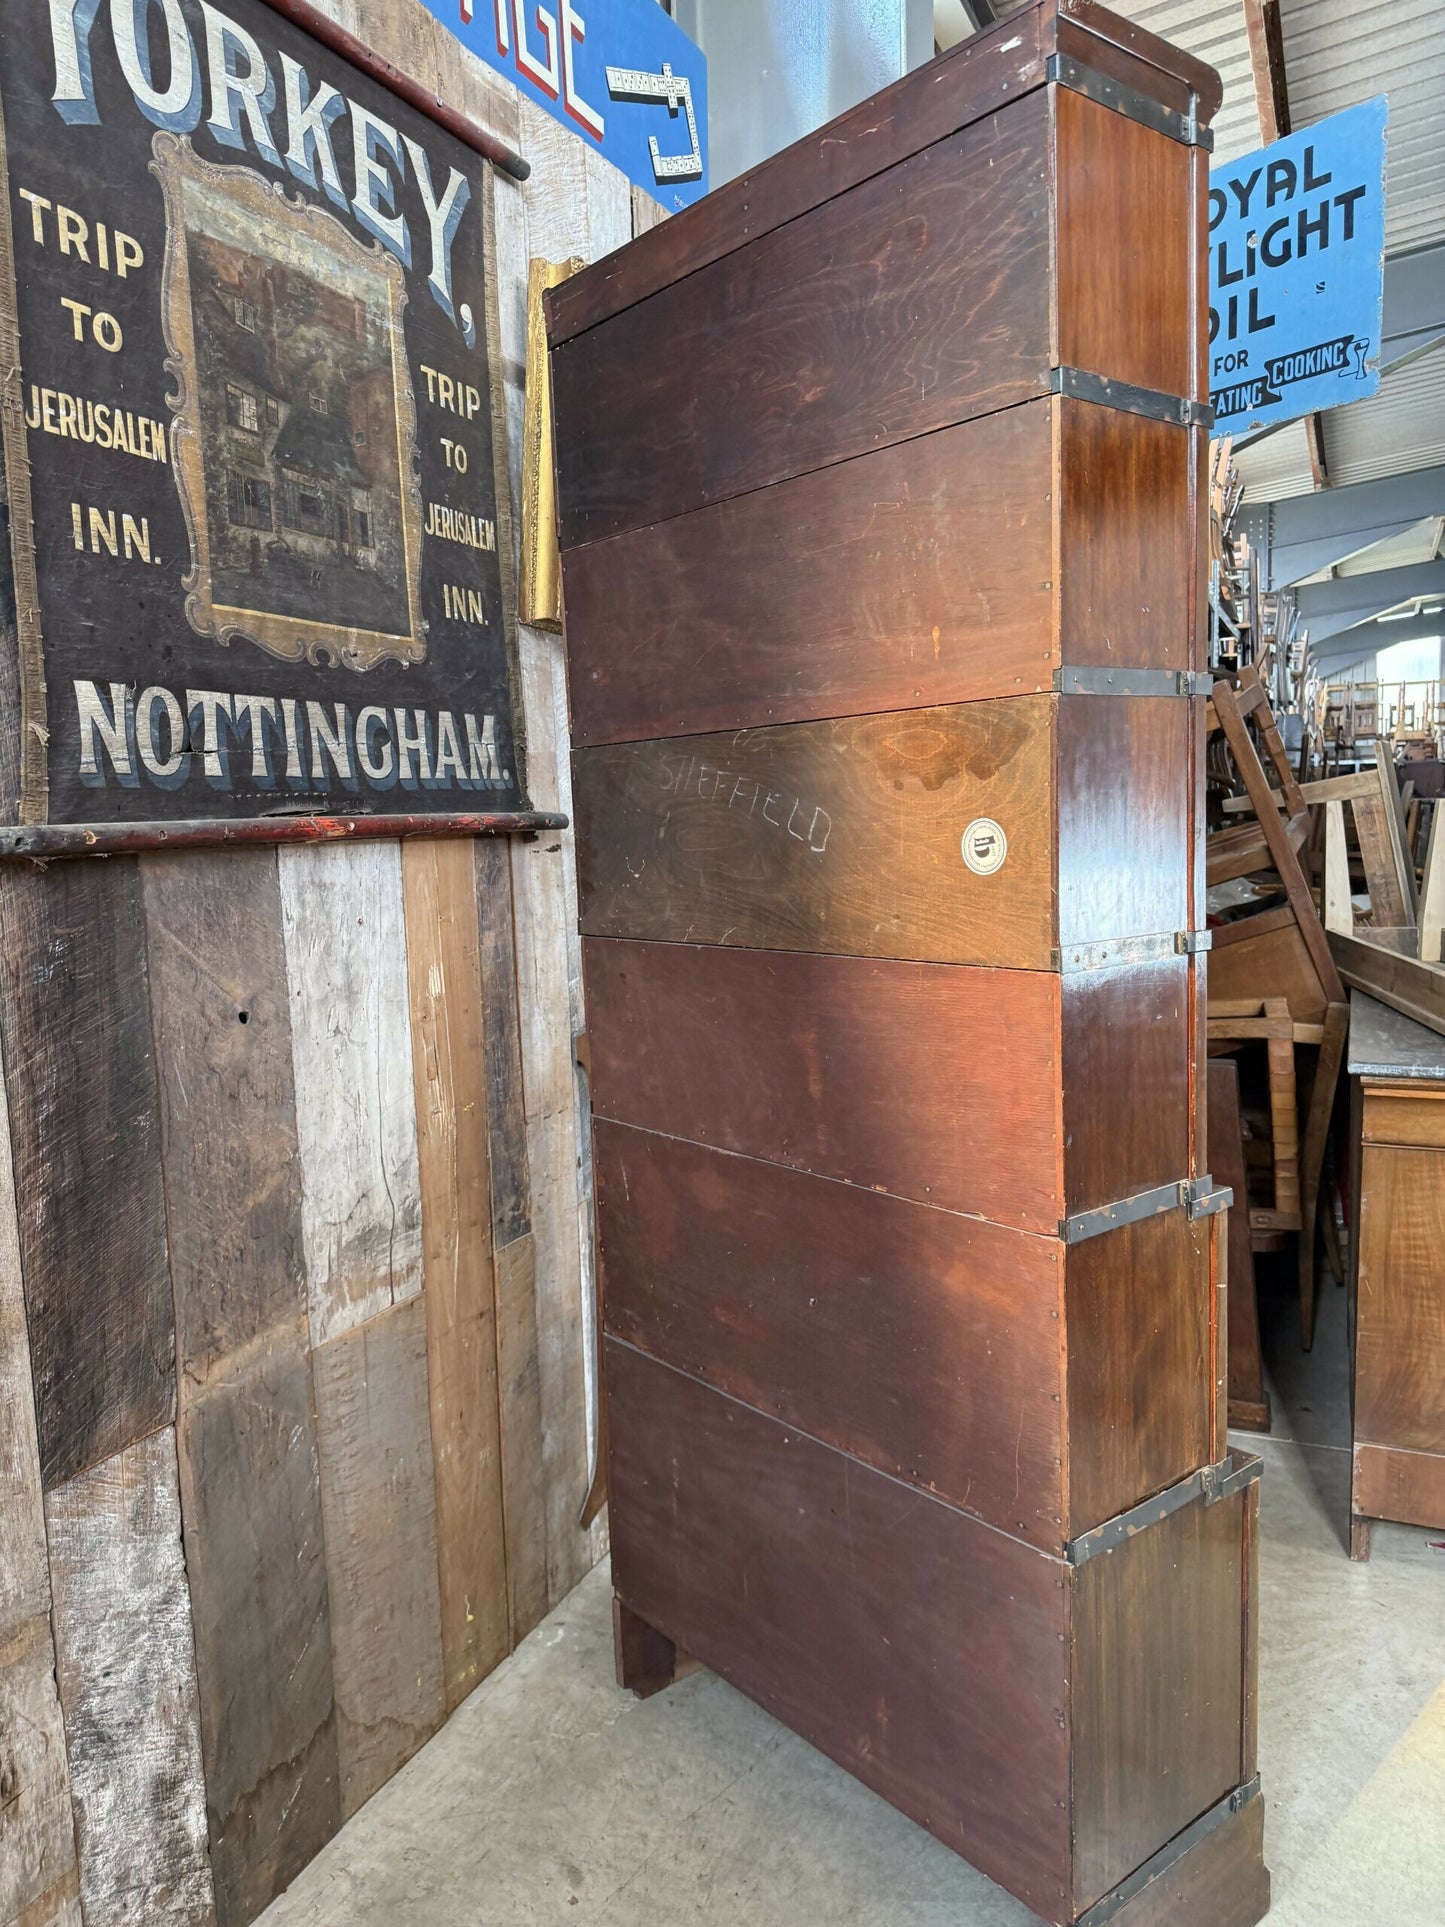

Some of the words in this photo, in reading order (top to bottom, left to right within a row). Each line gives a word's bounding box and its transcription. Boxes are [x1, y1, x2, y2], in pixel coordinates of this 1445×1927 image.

[19, 187, 144, 279] TRIP
[1209, 184, 1366, 288] LIGHT
[60, 296, 124, 353] TO
[1214, 349, 1249, 377] FOR
[1272, 341, 1344, 386] COOKING
[420, 364, 481, 421] TRIP
[25, 384, 167, 464] JERUSALEM
[439, 437, 468, 475] TO
[71, 502, 161, 565] INN.
[424, 502, 496, 552] JERUSALEM
[443, 583, 489, 627] INN.
[73, 679, 513, 790] NOTTINGHAM.
[660, 753, 832, 852] SHEFFIELD
